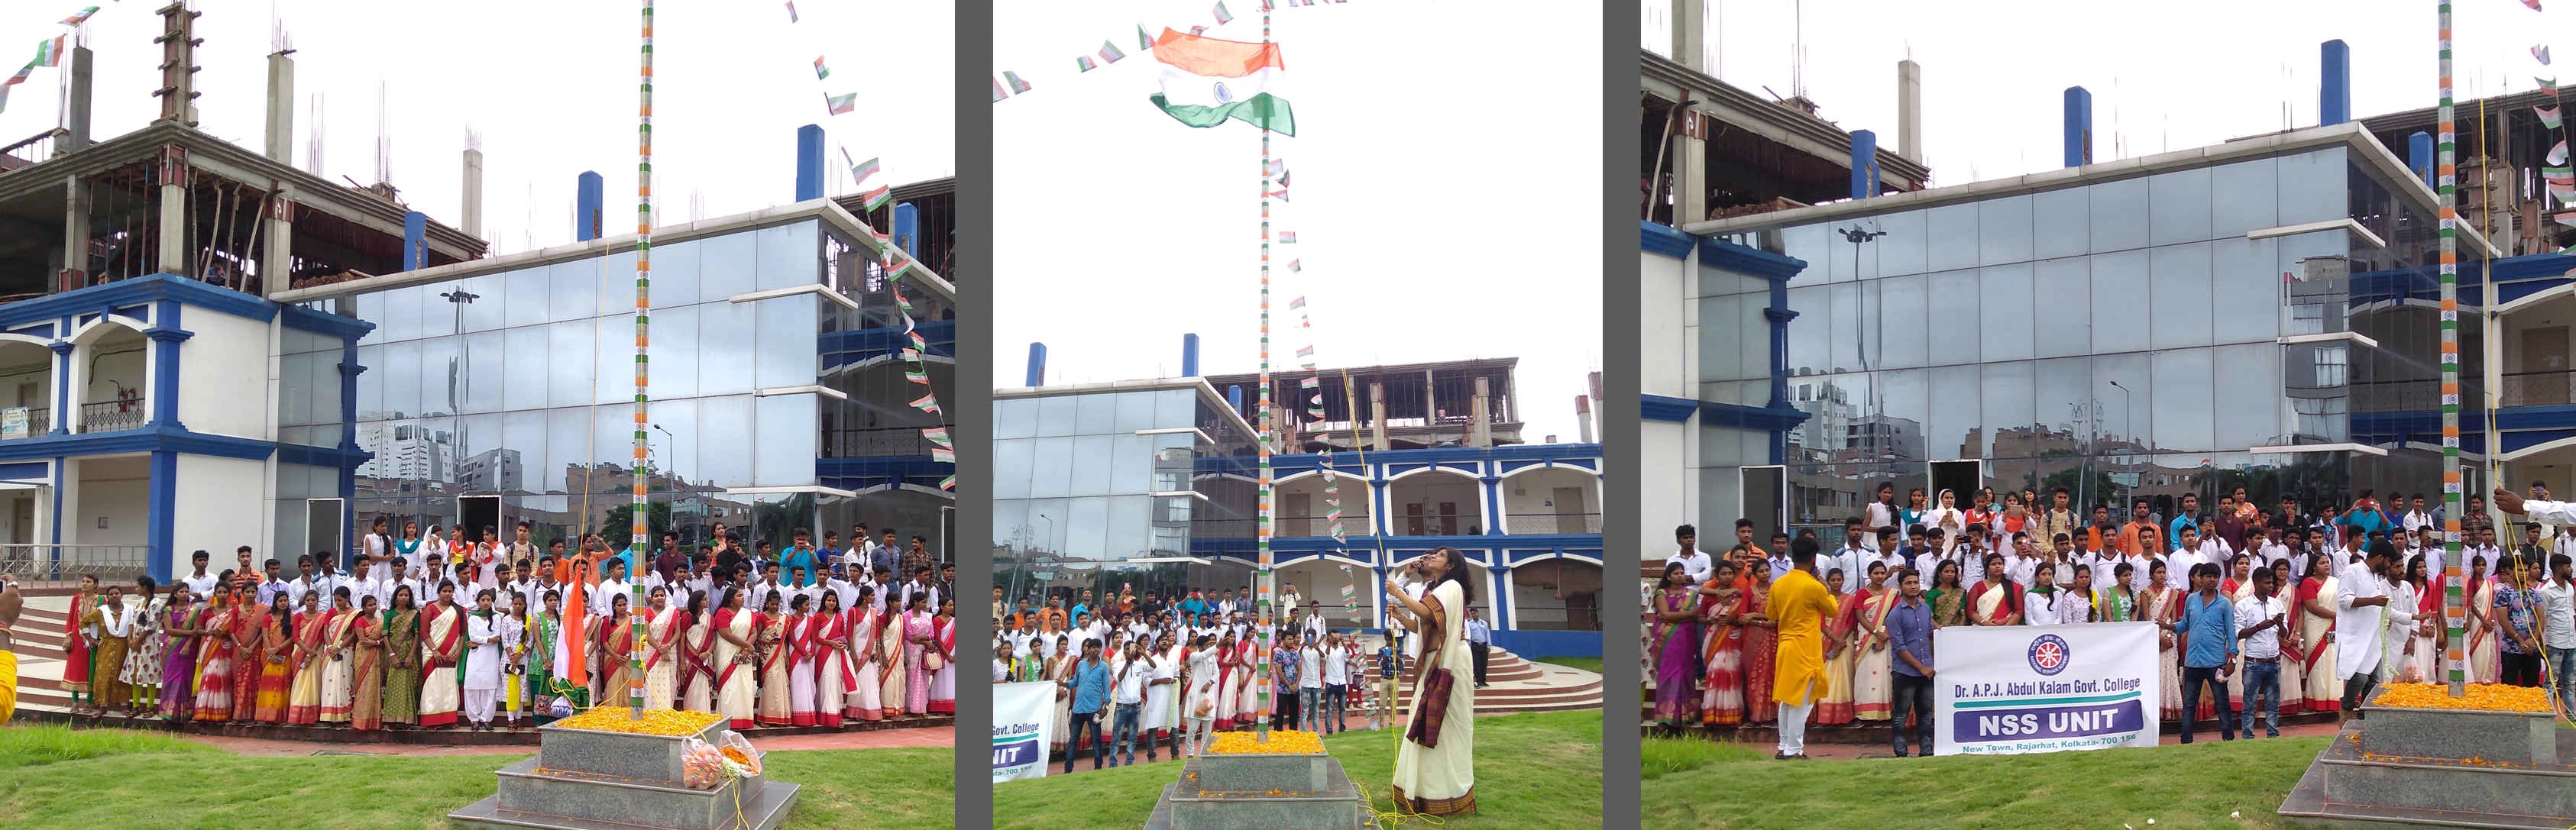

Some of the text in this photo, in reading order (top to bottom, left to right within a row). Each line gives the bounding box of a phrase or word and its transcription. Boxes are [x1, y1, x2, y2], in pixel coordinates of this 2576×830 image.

[1955, 677, 2141, 698] Dr. A.P.J. Abdul Kalam Govt. College
[1012, 723, 1039, 734] College
[1979, 708, 2119, 737] NSS UNIT
[1986, 744, 2014, 752] Town,
[2016, 742, 2058, 751] Rajarhat,
[2101, 737, 2118, 745] 700
[2120, 734, 2137, 743] 156
